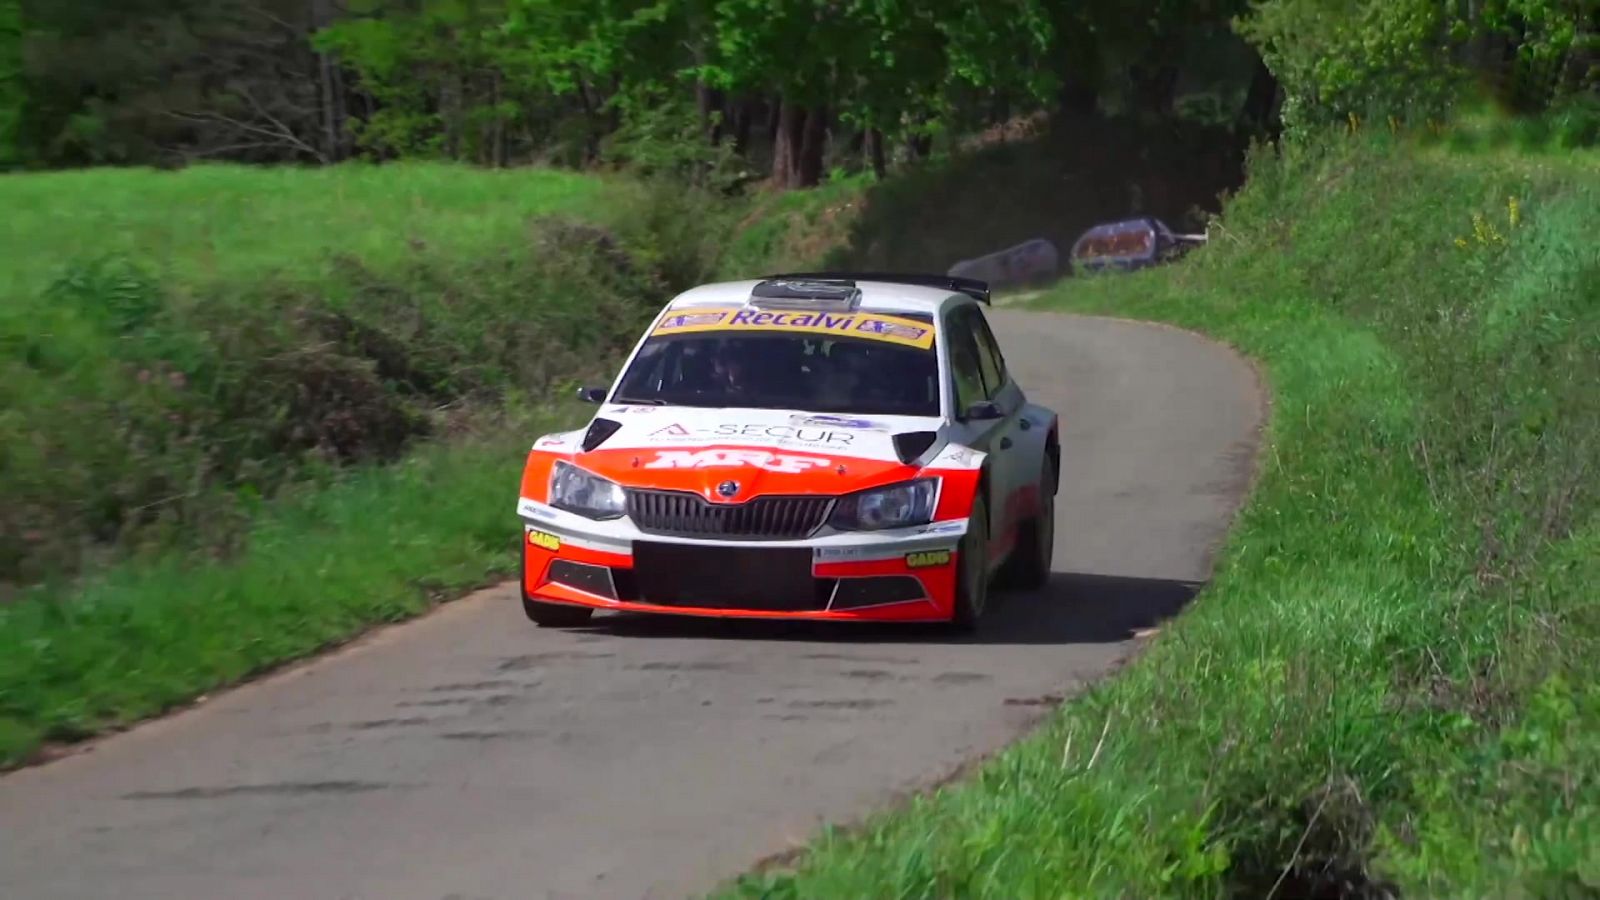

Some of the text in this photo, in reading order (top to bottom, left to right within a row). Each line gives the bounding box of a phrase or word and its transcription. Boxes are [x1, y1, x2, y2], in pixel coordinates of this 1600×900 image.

[729, 310, 856, 330] Recalvi
[649, 423, 854, 445] A-SECUR
[644, 450, 831, 474] MRF
